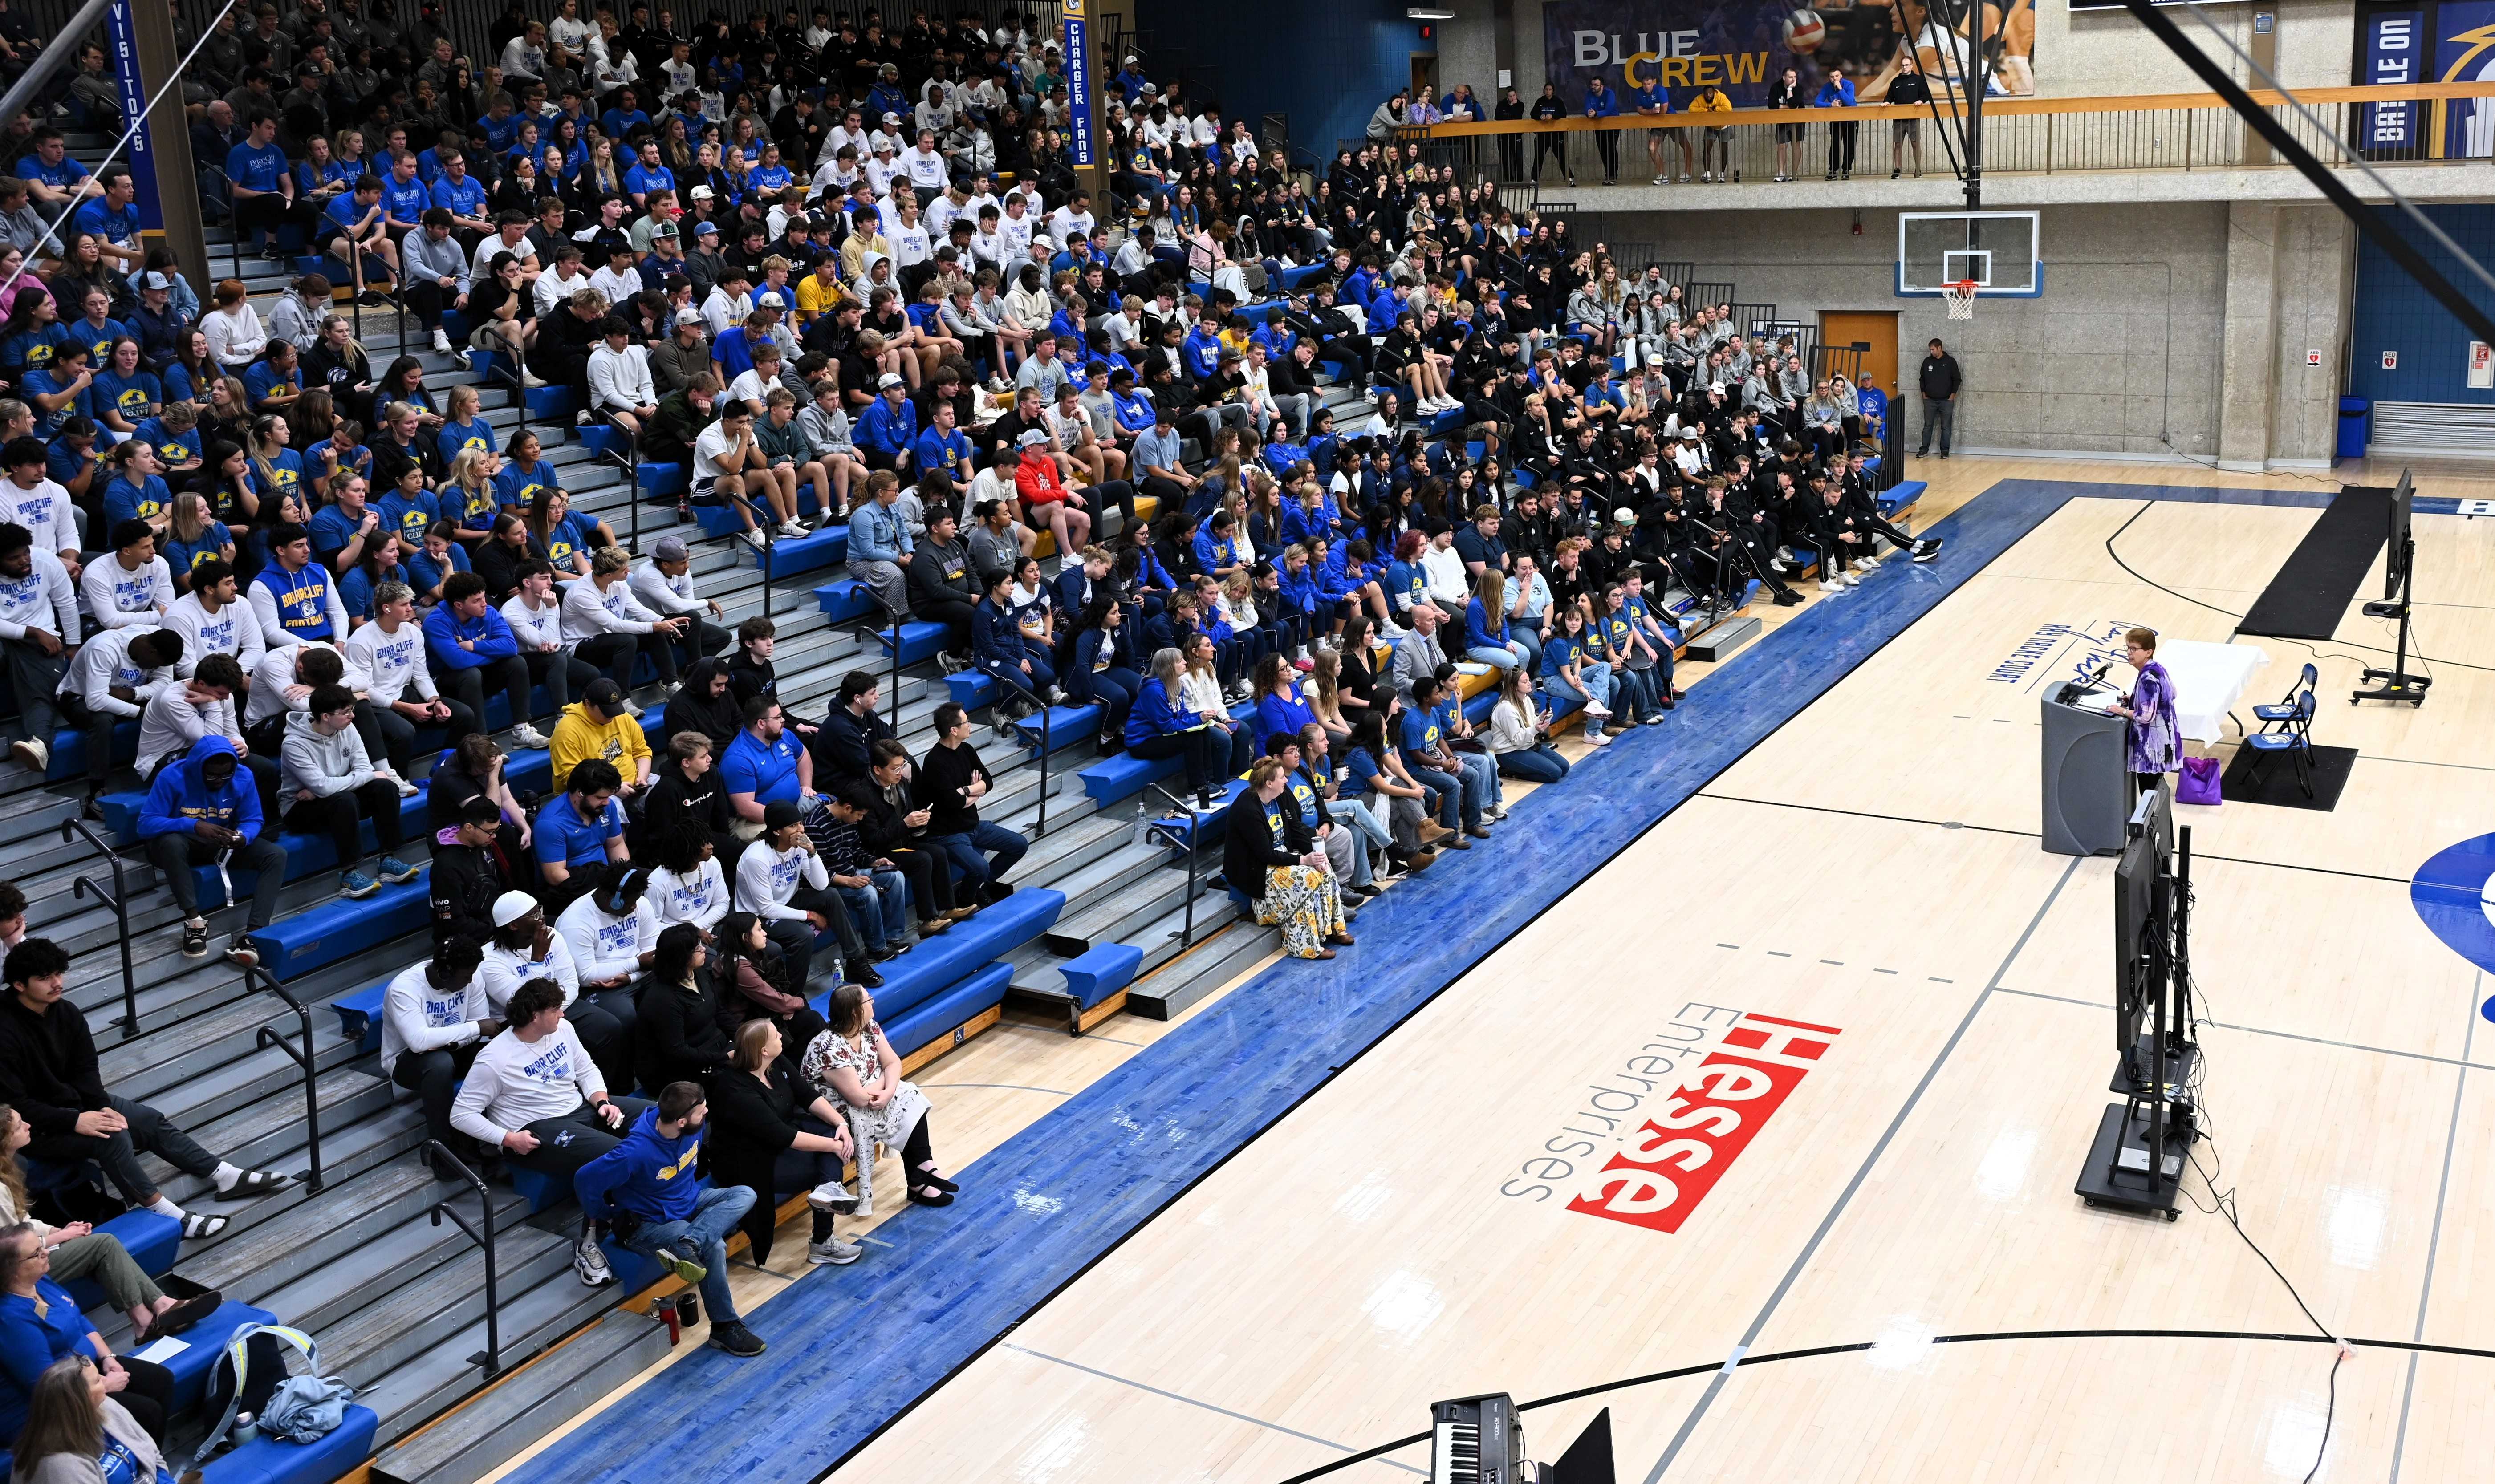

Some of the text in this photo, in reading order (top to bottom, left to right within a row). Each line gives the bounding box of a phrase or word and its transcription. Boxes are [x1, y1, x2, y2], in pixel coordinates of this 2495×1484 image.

[1573, 29, 1701, 67] BLUE
[113, 3, 144, 151] VISITORS
[1624, 52, 1769, 89] CREW
[1070, 24, 1088, 162] CHARGER FANS
[2374, 58, 2408, 141] BATLE
[126, 410, 150, 418] CLIFF
[20, 573, 41, 588] CLIFF
[200, 625, 219, 638] BRIAR
[395, 639, 414, 653] CLIFF
[1986, 624, 2072, 683] RAY NACKE COURT
[683, 791, 713, 806] Champion
[785, 854, 801, 872] CLIFF
[686, 892, 703, 902] FOOTBALL
[681, 903, 689, 912] BC
[616, 916, 637, 935] CLIFF
[447, 991, 464, 1009] CLIFF
[524, 1042, 568, 1078] BRIAR CLIFF
[534, 1062, 560, 1077] FOOTBALL
[1501, 1002, 1743, 1203] Enterprises
[1572, 1014, 1838, 1222] Hesse
